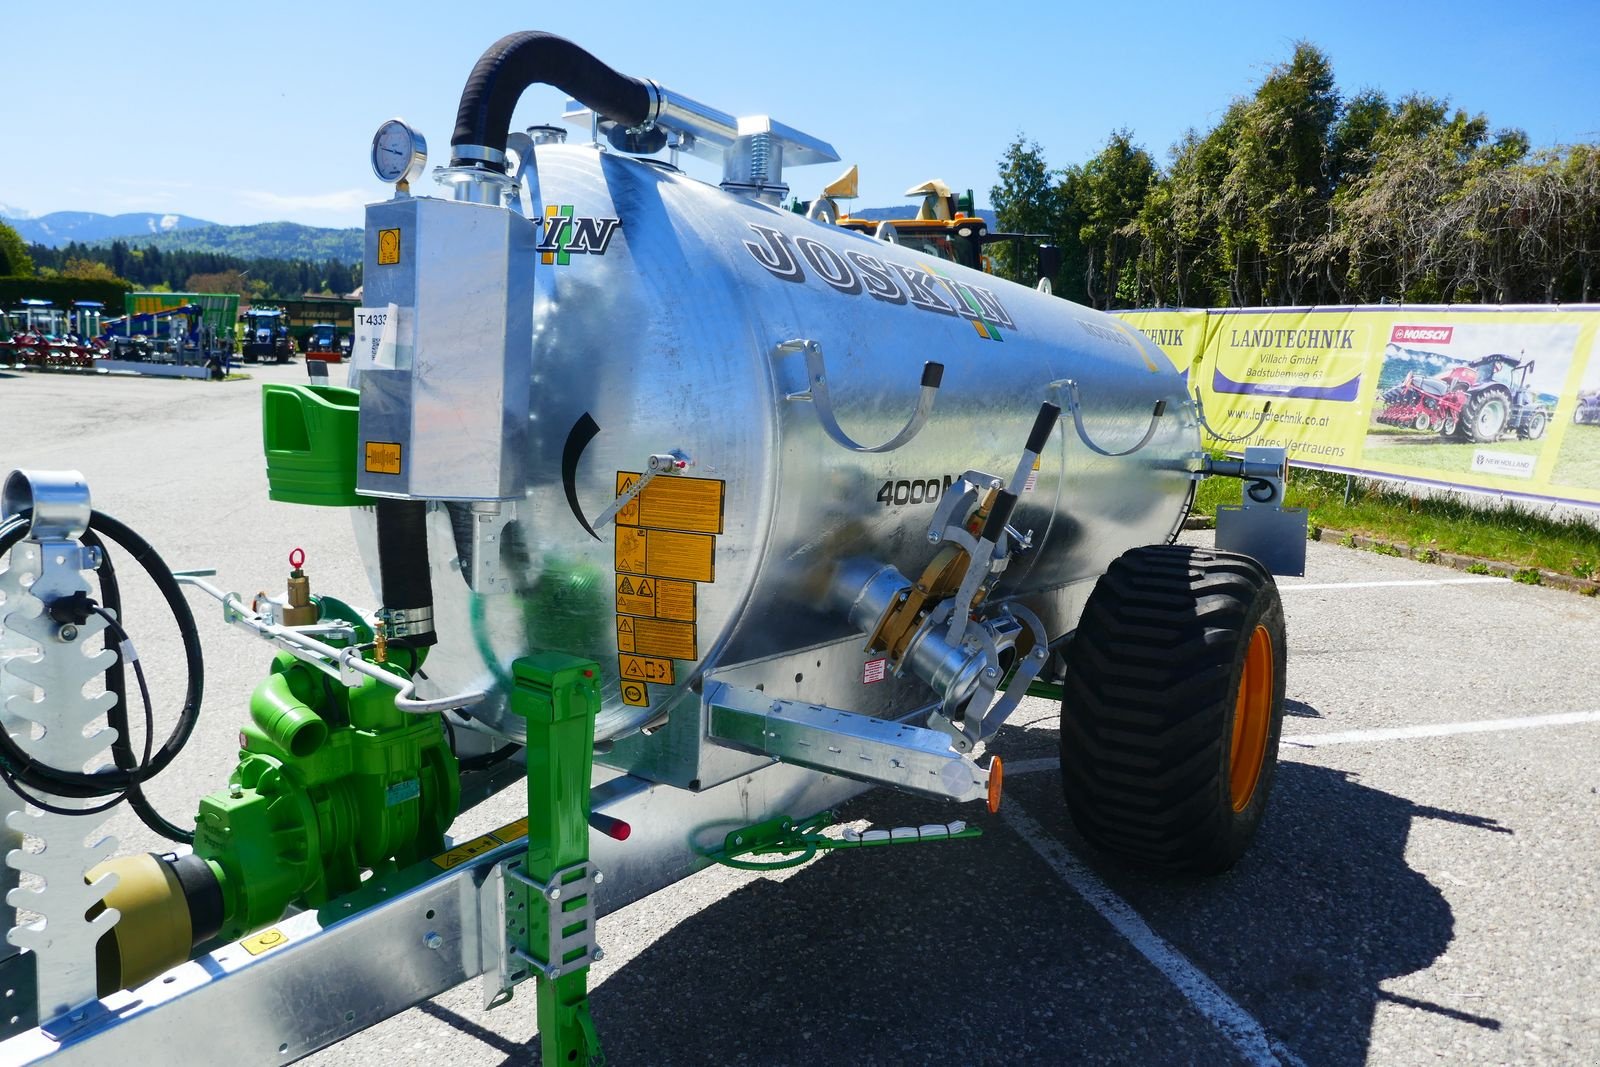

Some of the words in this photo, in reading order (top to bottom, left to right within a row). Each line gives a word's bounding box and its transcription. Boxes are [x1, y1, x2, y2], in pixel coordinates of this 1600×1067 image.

[529, 216, 623, 255] IN
[742, 222, 1018, 331] JOSKIN
[1139, 328, 1184, 346] HNIK
[1230, 329, 1355, 349] LANDTECHNIK
[1403, 329, 1450, 341] HORSCH
[1260, 353, 1288, 365] Villach
[1289, 354, 1319, 365] GmbH
[1246, 367, 1310, 380] Badstubenweg
[1227, 407, 1330, 427] www.ladtechnik.co.at
[1254, 434, 1281, 447] Ihres
[1284, 438, 1346, 457] Vertrauens
[1500, 460, 1530, 469] HOLLAND
[876, 475, 979, 506] 4000
